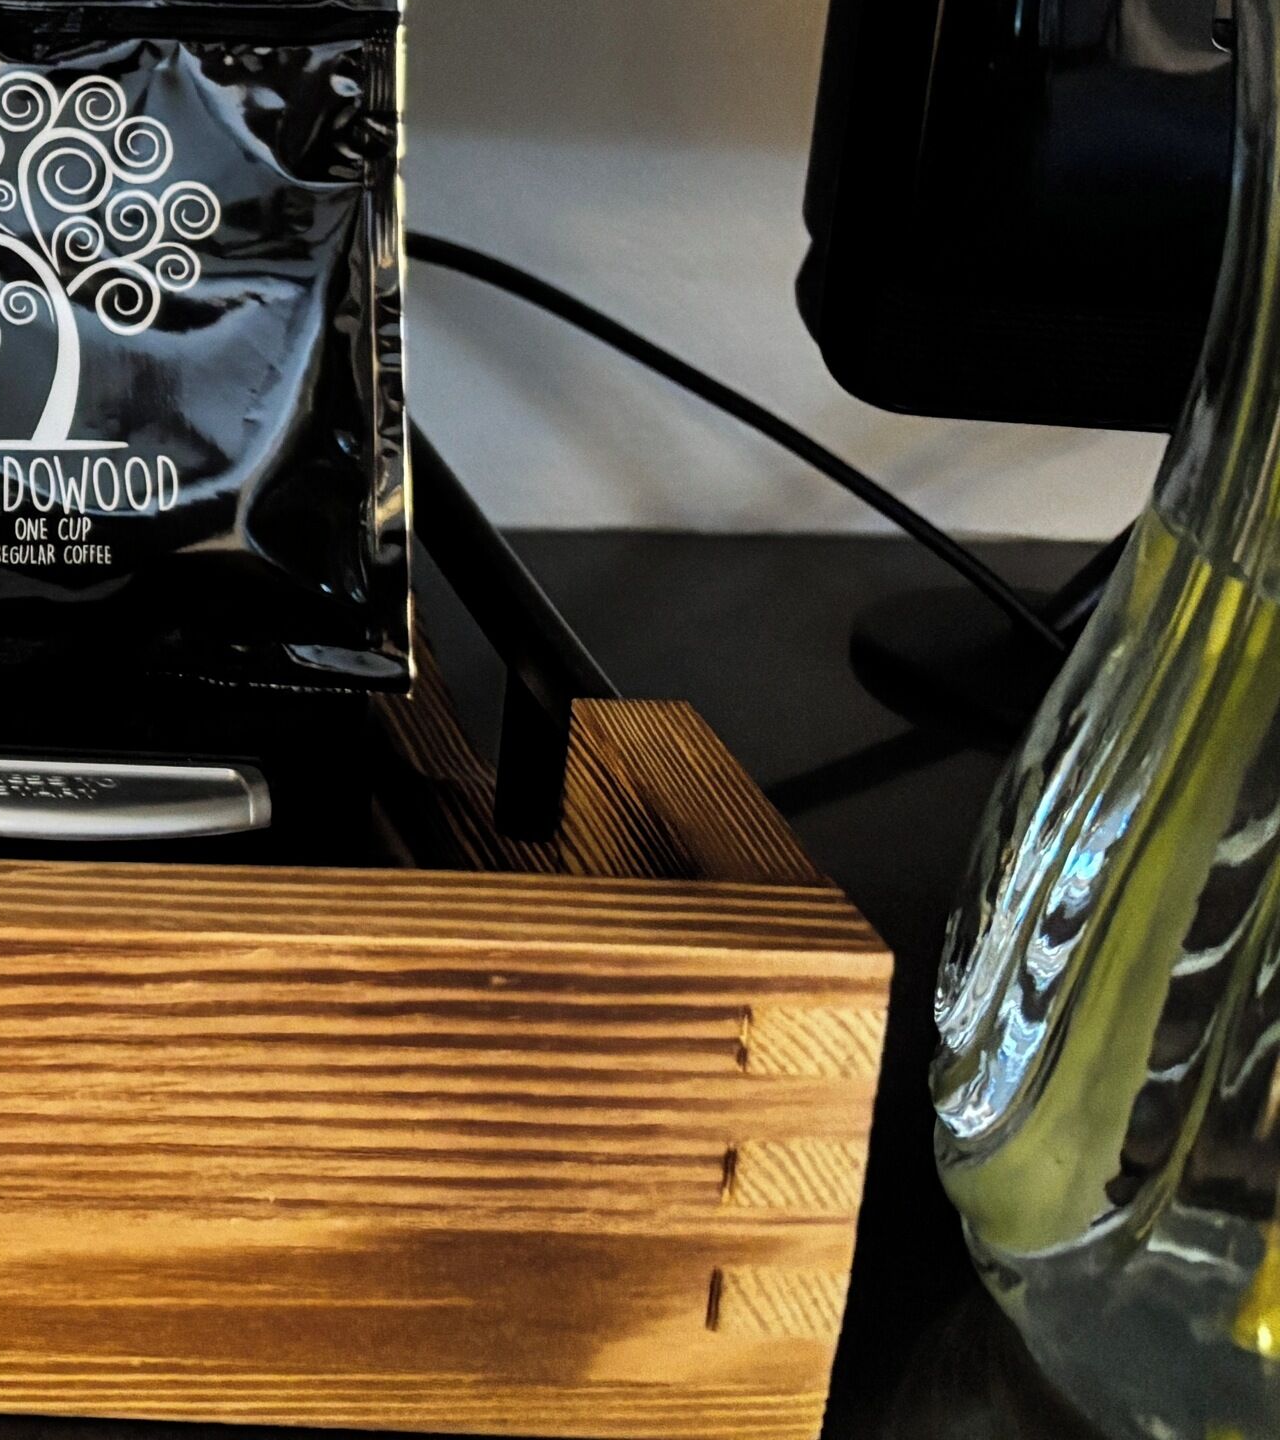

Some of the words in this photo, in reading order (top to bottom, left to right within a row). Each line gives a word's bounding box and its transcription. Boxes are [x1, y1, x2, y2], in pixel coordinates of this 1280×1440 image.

[14, 517, 48, 541] ONE
[57, 516, 92, 541] CUP
[63, 544, 112, 565] COFFEE
